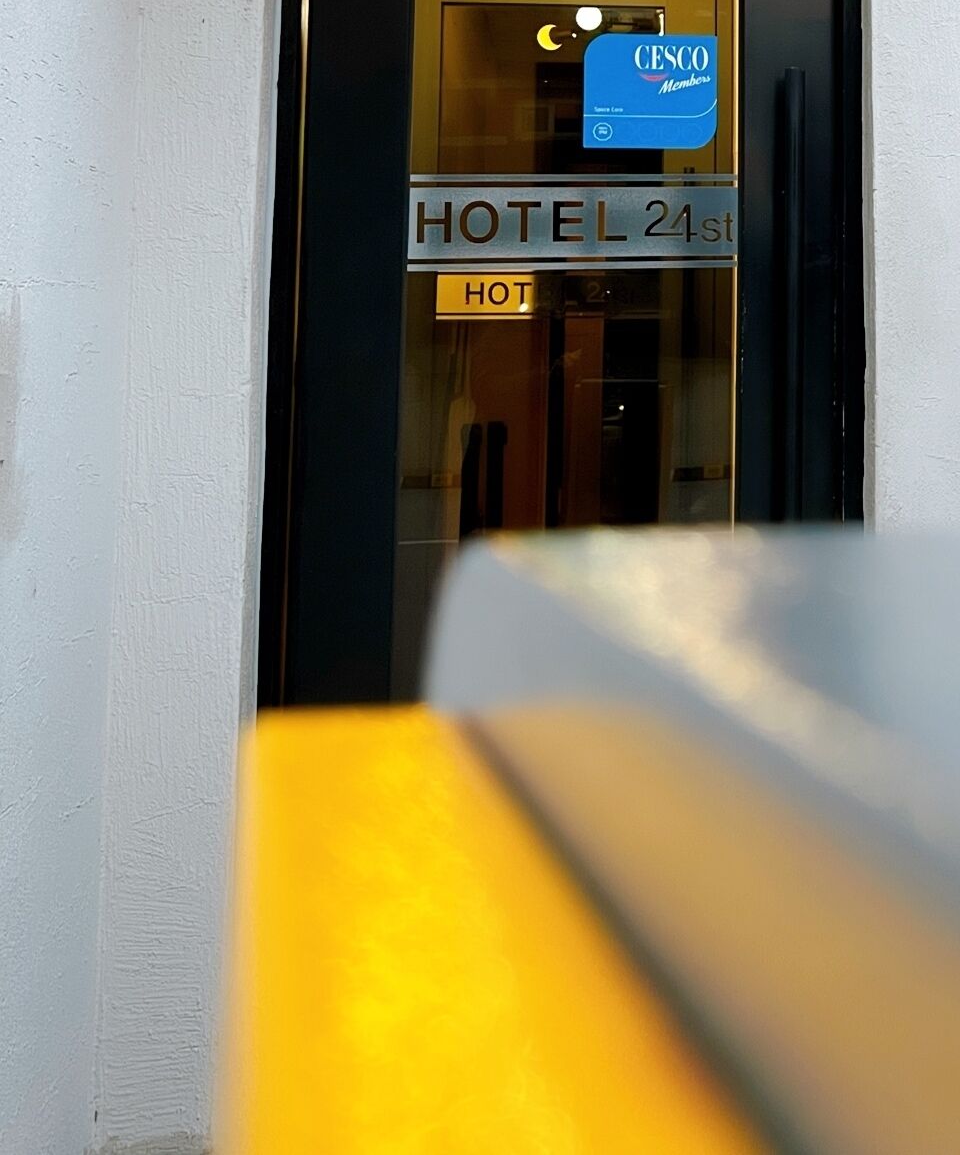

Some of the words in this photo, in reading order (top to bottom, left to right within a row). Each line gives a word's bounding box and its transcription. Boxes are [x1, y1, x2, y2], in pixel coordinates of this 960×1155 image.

[634, 44, 709, 71] CESCO
[658, 73, 711, 94] Members
[416, 200, 627, 244] HOTEL
[465, 281, 533, 306] HOT
